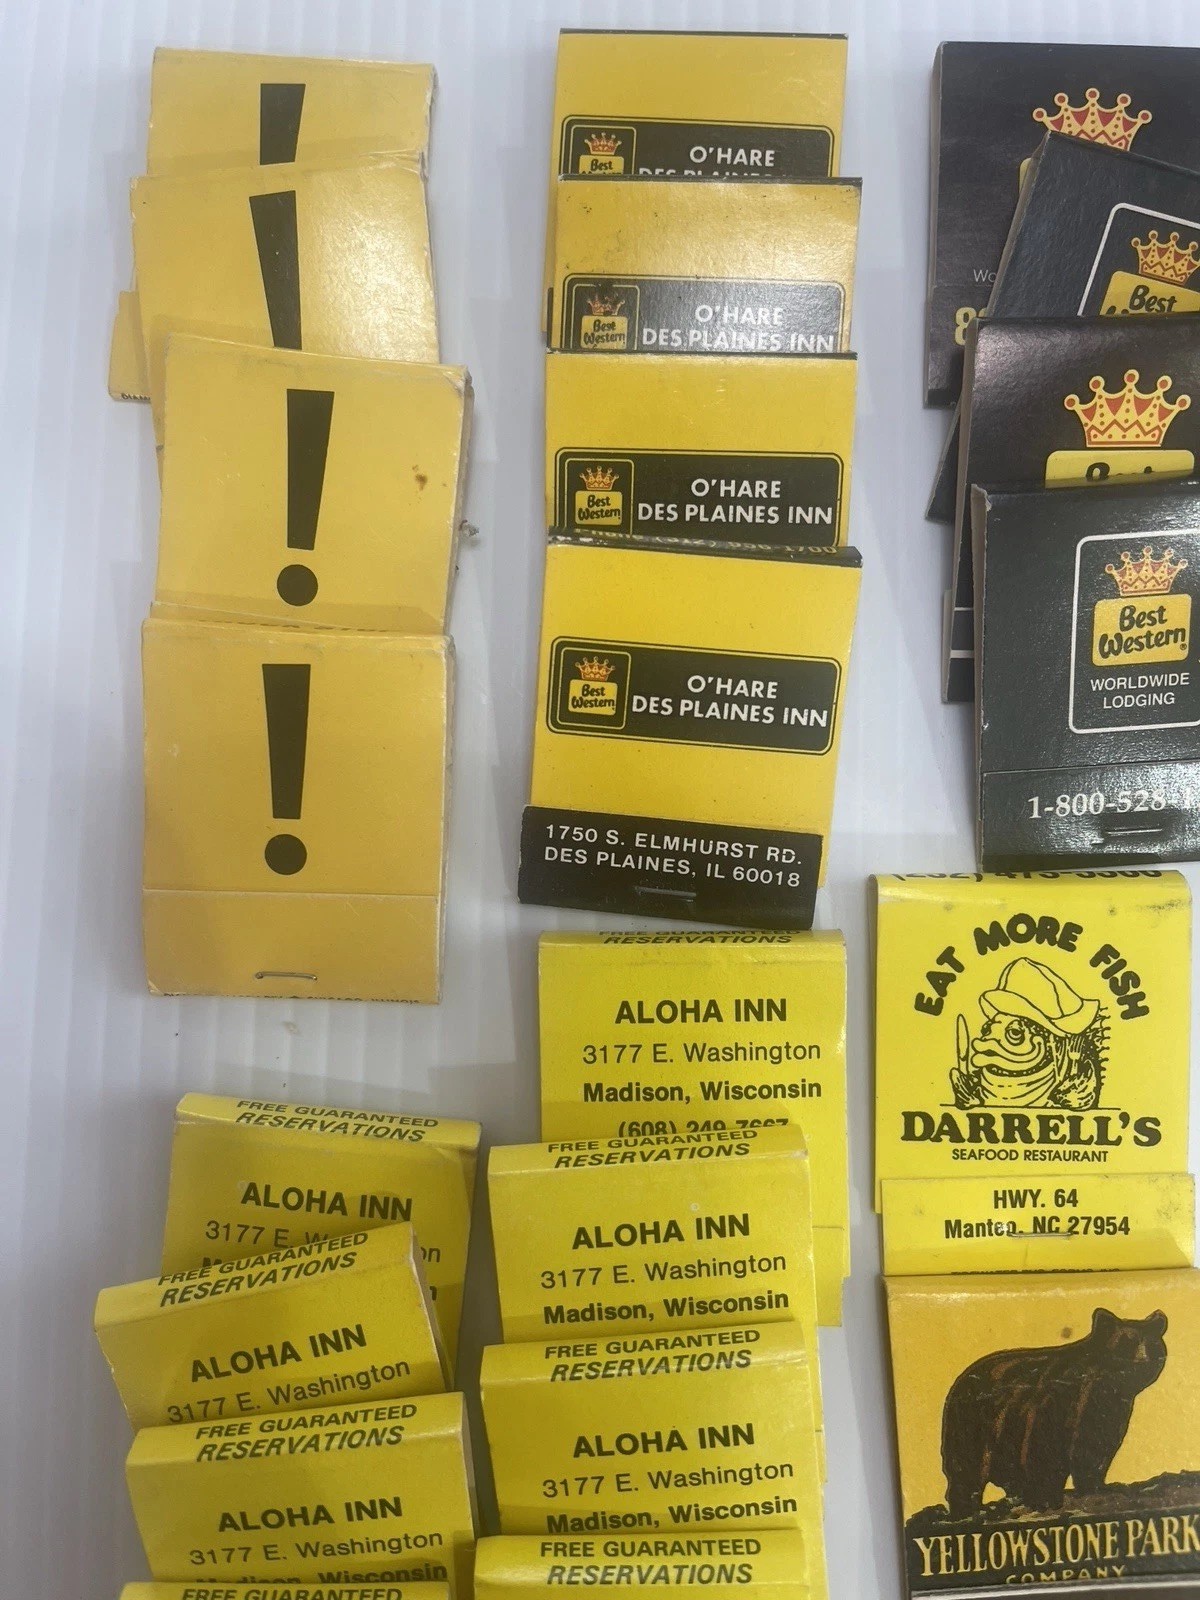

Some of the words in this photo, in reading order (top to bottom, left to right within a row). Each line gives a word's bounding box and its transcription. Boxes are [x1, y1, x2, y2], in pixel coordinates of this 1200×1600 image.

[590, 158, 613, 171] Best
[689, 145, 776, 167] O'HARE
[1129, 284, 1178, 313] Best
[593, 318, 617, 332] Best
[694, 304, 784, 326] O'HARE
[583, 331, 626, 346] Western
[641, 327, 682, 348] DES
[688, 329, 783, 351] PLAINES
[789, 333, 835, 352] INN
[587, 495, 612, 508] Best
[691, 478, 782, 498] O'HARE
[577, 507, 621, 521] Western
[637, 502, 679, 522] DES
[685, 504, 780, 524] PLAINES
[787, 506, 833, 525] INN
[1119, 605, 1168, 632] Best
[1098, 627, 1187, 659] Western
[581, 684, 606, 698] Best
[687, 674, 778, 700] O'HARE
[1091, 672, 1190, 692] WORLDWIDE
[570, 697, 616, 710] Western
[631, 695, 673, 717] DES
[679, 699, 775, 726] PLAINES
[782, 707, 828, 728] INN
[1103, 692, 1176, 710] LODGING
[546, 824, 599, 844] 1750
[605, 829, 625, 846] S.
[635, 832, 759, 860] ELMHURST
[766, 846, 803, 866] RD.
[544, 846, 588, 866] DES
[596, 851, 697, 878] PLAINES,
[706, 863, 726, 880] IL
[732, 867, 801, 888] 60018
[603, 935, 793, 945] RESERVATIONS
[913, 945, 966, 1017] EAT
[973, 912, 1084, 956] MORE
[1089, 943, 1150, 1020] FISH
[615, 1000, 723, 1024] ALOHA
[734, 998, 787, 1022] INN
[583, 1044, 643, 1064] 3177
[653, 1043, 674, 1063] E.
[683, 1041, 821, 1065] Washington
[583, 1082, 691, 1104] Madison,
[700, 1078, 822, 1100] Wisconsin
[235, 1111, 426, 1142] RESERVATIONS
[236, 1100, 289, 1115] FREE
[294, 1105, 439, 1128] GUARANTEED
[548, 1140, 599, 1153] FREE
[607, 1129, 758, 1149] GUARANTEED
[900, 1110, 1162, 1147] DARRELL'S
[554, 1142, 750, 1169] RESERVATIONS
[951, 1148, 1019, 1161] SEAFOOD
[1023, 1149, 1108, 1163] RESTAURANT
[240, 1182, 348, 1216] ALOHA
[359, 1194, 412, 1221] INN
[993, 1189, 1046, 1210] HWY.
[1054, 1188, 1078, 1208] 64
[205, 1220, 265, 1245] 3177
[572, 1220, 685, 1250] ALOHA
[696, 1213, 750, 1240] INN
[1032, 1216, 1060, 1236] NC
[1067, 1216, 1130, 1236] 27954
[158, 1268, 211, 1286] FREE
[218, 1232, 368, 1274] GUARANTEED
[540, 1267, 602, 1289] 3177
[612, 1265, 635, 1284] E.
[644, 1254, 786, 1281] Washington
[160, 1251, 357, 1308] RESERVATIONS
[543, 1301, 654, 1325] Madison,
[663, 1289, 789, 1318] Wisconsin
[191, 1341, 302, 1383] ALOHA
[308, 1324, 367, 1358] INN
[545, 1343, 597, 1360] FREE
[605, 1329, 760, 1355] GUARANTEED
[550, 1349, 752, 1383] RESERVATIONS
[167, 1397, 226, 1424] 3177
[236, 1393, 261, 1412] E.
[266, 1361, 411, 1407] Washington
[196, 1422, 253, 1440] FREE
[259, 1404, 417, 1433] GUARANTEED
[196, 1425, 405, 1463] RESERVATIONS
[573, 1430, 688, 1458] ALOHA
[698, 1423, 755, 1449] INN
[542, 1475, 605, 1498] 3177
[615, 1473, 639, 1493] E.
[647, 1462, 794, 1490] Washington
[218, 1503, 334, 1533] ALOHA
[344, 1496, 403, 1523] INN
[546, 1509, 661, 1534] Madison,
[668, 1495, 798, 1525] Wisconsin
[189, 1547, 252, 1566] 3177
[263, 1545, 287, 1562] E.
[295, 1532, 443, 1560] Washington
[540, 1542, 595, 1557] FREE
[603, 1538, 761, 1557] GUARANTEED
[913, 1521, 1120, 1577] YELLOWSTONE
[1125, 1513, 1200, 1557] PARK
[547, 1563, 753, 1585] RESERVATIONS
